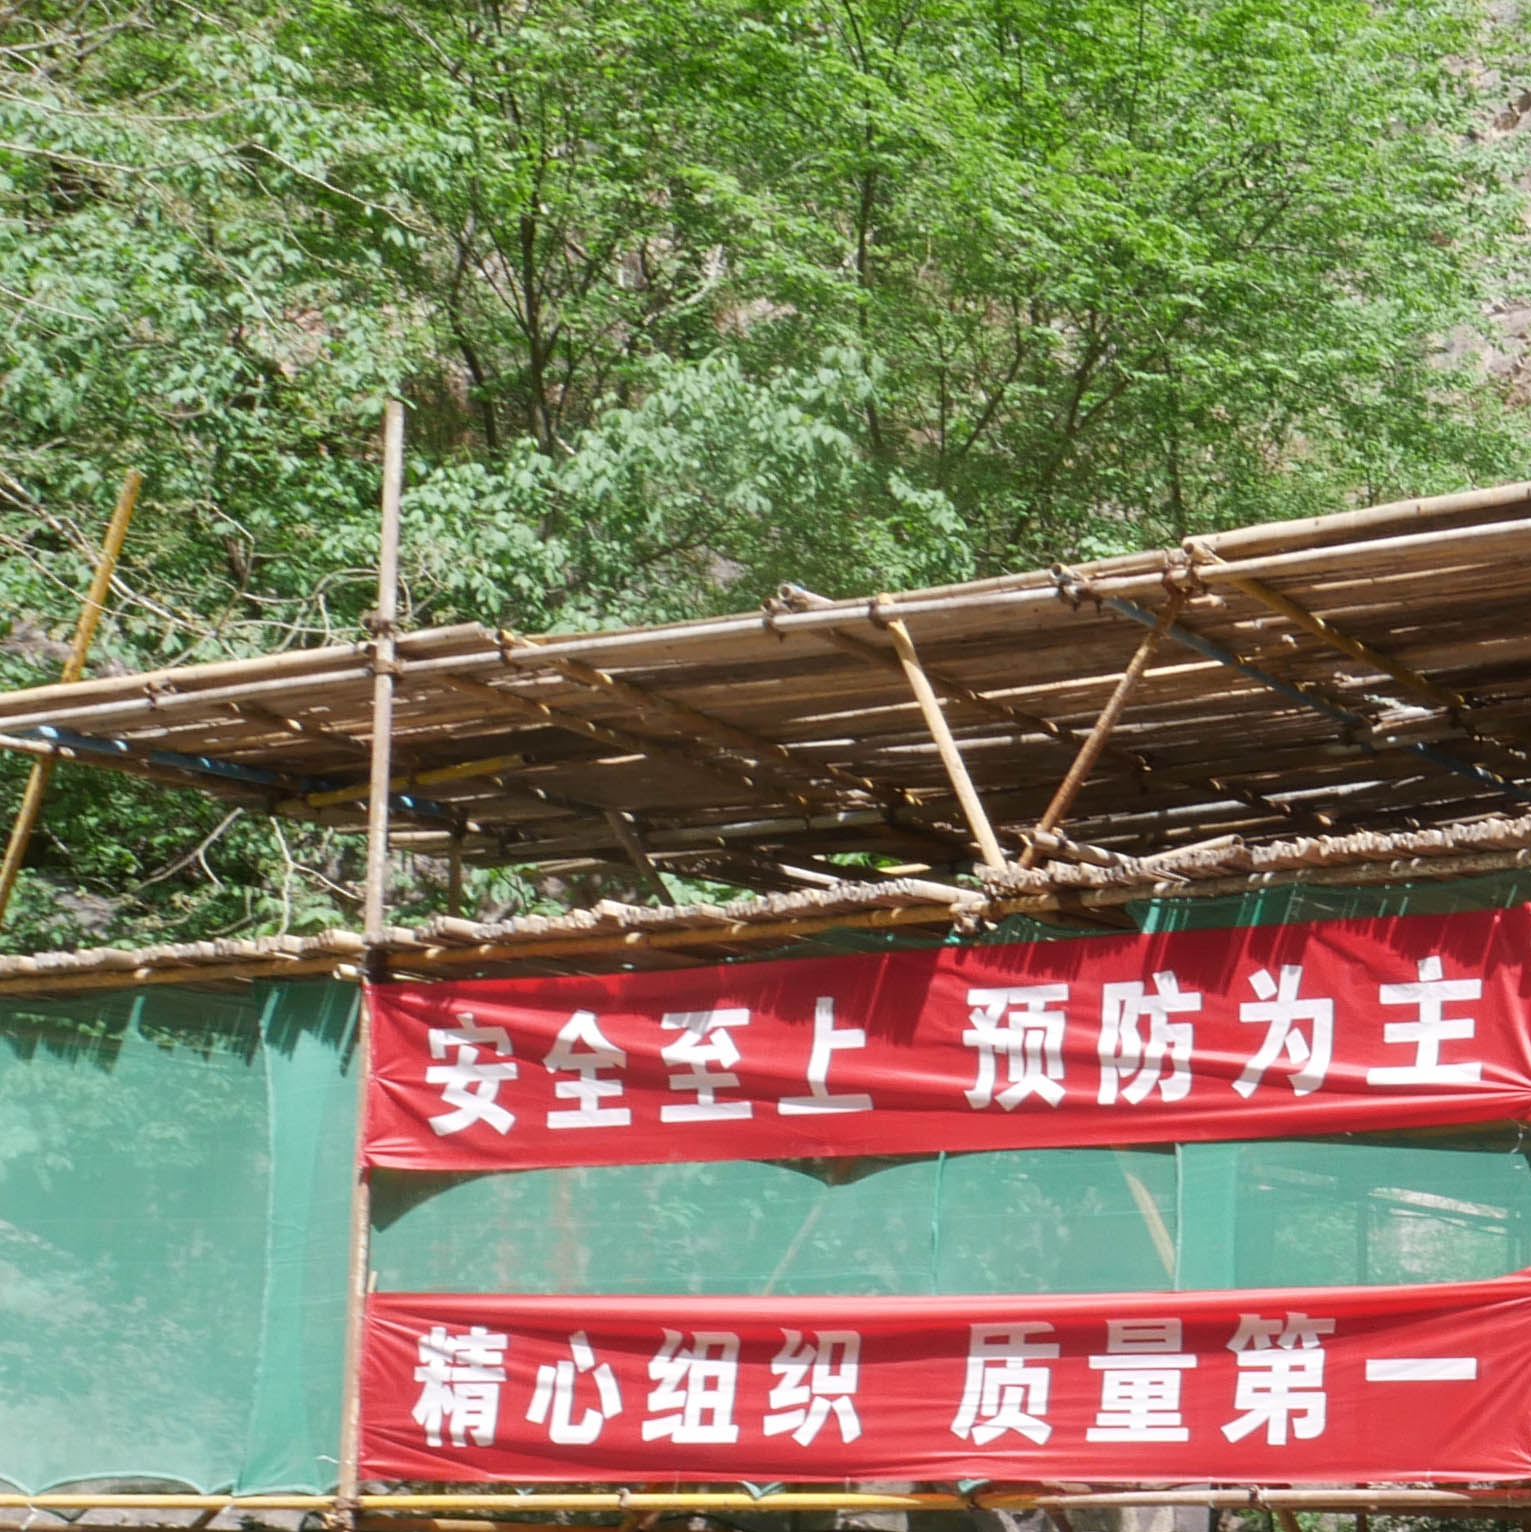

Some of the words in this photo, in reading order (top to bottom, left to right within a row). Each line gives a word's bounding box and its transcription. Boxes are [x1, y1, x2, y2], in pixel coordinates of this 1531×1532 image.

[425, 996, 874, 1137] 安全至上
[961, 955, 1482, 1112] 预防为主
[411, 1326, 864, 1448] 精心组织
[950, 1312, 1478, 1446] 质量第一
